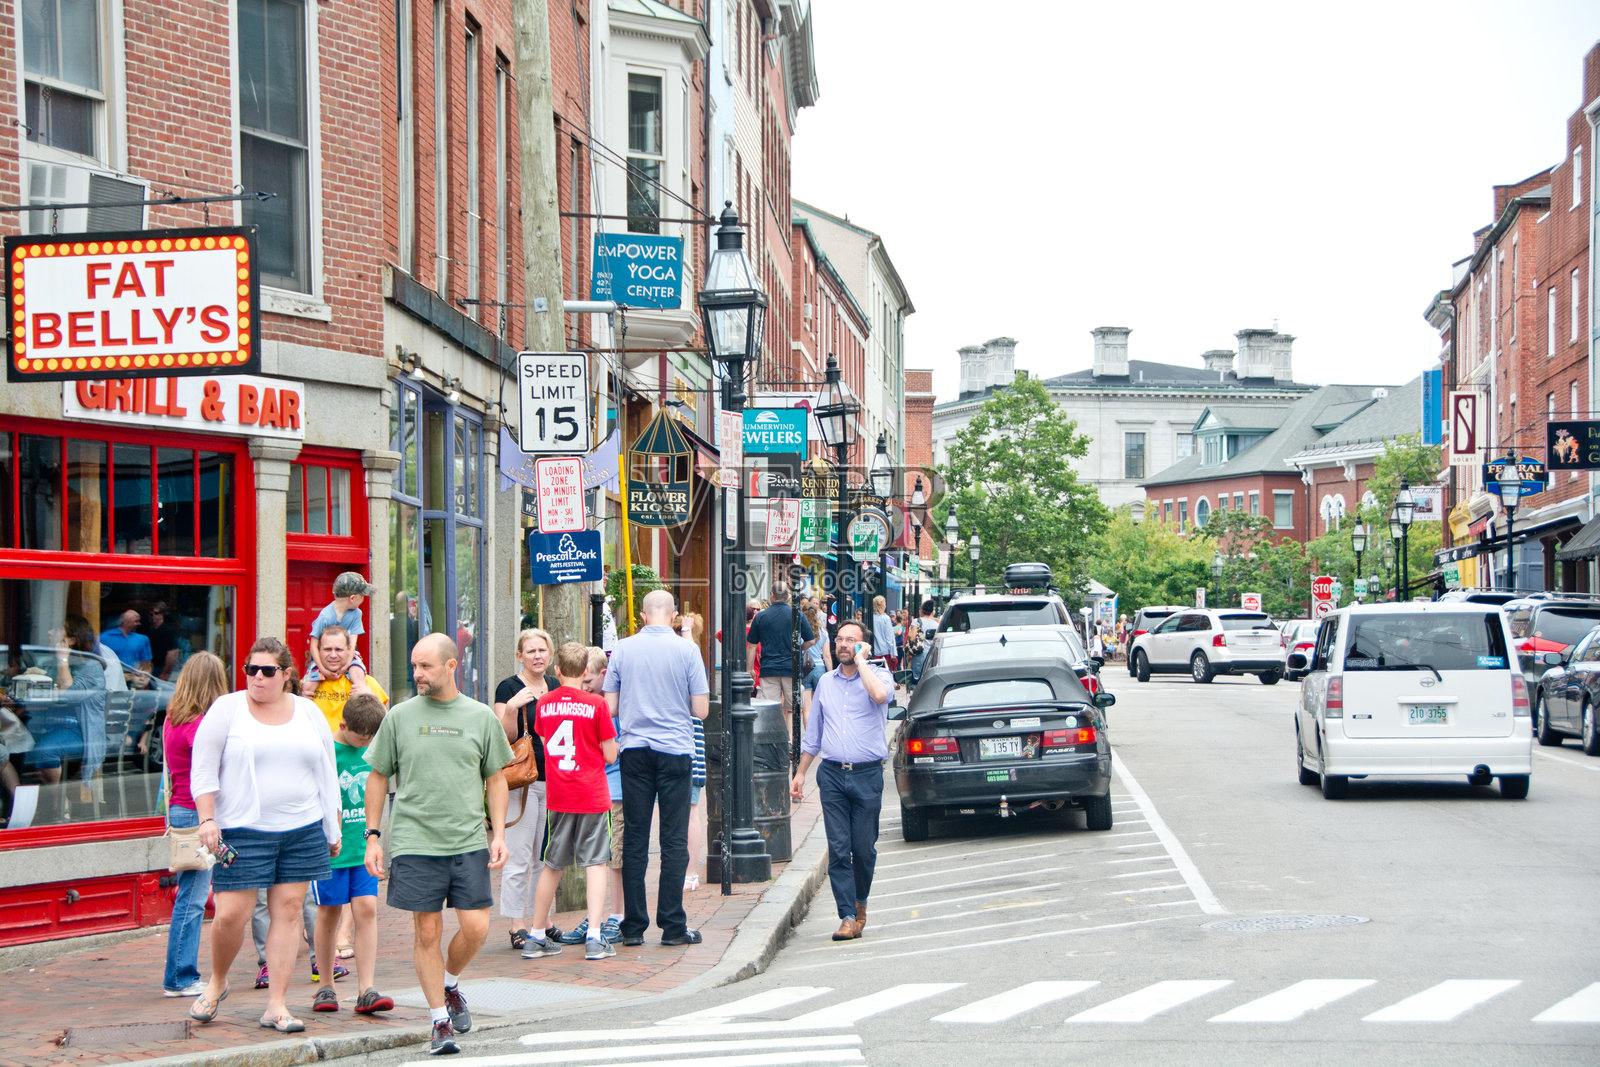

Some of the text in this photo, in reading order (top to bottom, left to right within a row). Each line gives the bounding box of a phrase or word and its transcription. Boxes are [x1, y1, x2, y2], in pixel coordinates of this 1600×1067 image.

[597, 243, 677, 261] EMPOWER
[627, 262, 677, 280] YOGA
[85, 259, 175, 300] FAT
[626, 285, 675, 298] CENTER
[31, 304, 231, 350] BELLY'S
[523, 364, 582, 379] SPEED
[530, 385, 576, 400] LIMIT
[75, 377, 301, 430] GRILL & BAR
[535, 406, 579, 442] 15
[743, 431, 802, 444] EWELERS
[544, 465, 575, 476] LOADING
[1487, 464, 1543, 473] FERAL
[551, 476, 569, 486] ZONE
[767, 473, 800, 484] Siren
[801, 477, 840, 488] KENNEDY
[1494, 473, 1535, 481] CAR
[542, 486, 577, 497] 30 MINUTE
[630, 491, 687, 503] FLOWER
[802, 488, 840, 498] GALLERY
[551, 496, 569, 507] LIMIT
[803, 501, 810, 511] 3
[565, 508, 573, 516] SAT
[630, 502, 687, 513] KIOSK
[548, 518, 558, 526] 6AM
[564, 517, 575, 525] 7PM
[808, 517, 824, 527] PAY
[803, 526, 828, 536] METER
[536, 546, 597, 562] Prescott Park
[1313, 583, 1332, 594] STO
[540, 702, 596, 719] HJALMARSSON
[1410, 708, 1447, 719] 210 3755
[546, 719, 577, 771] 4
[993, 741, 1019, 754] 135 TY
[342, 807, 366, 819] ACK
